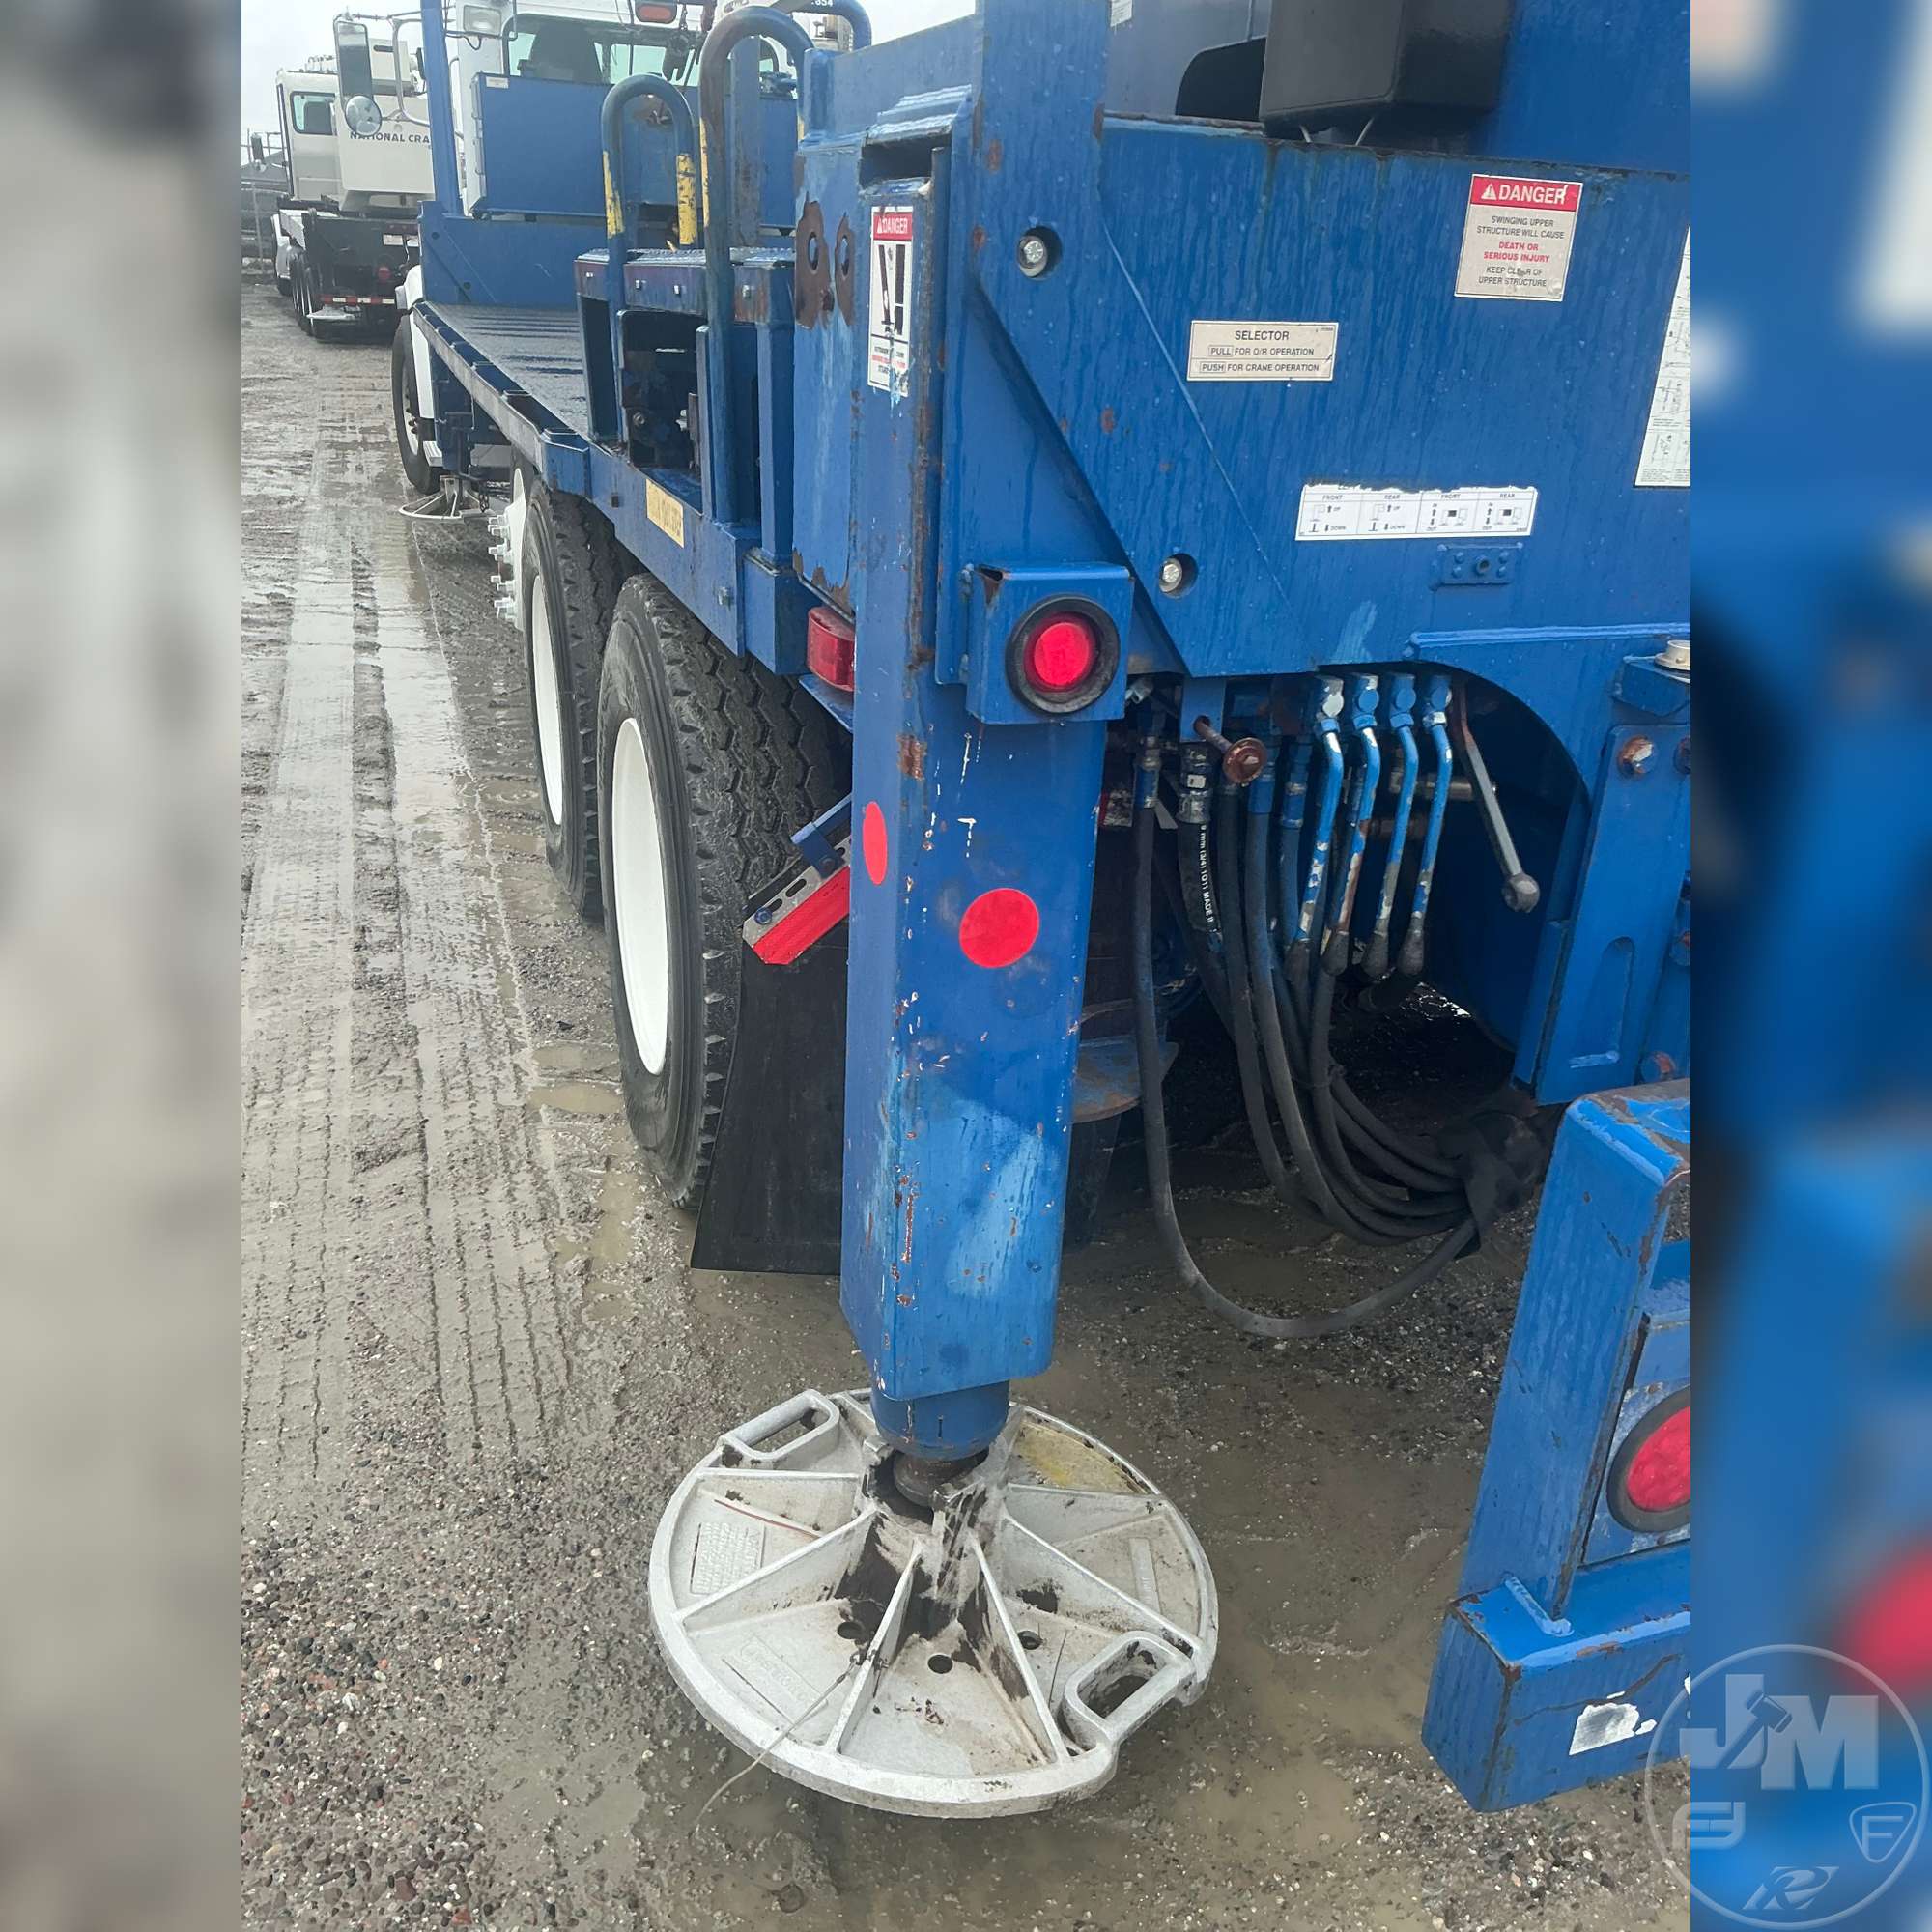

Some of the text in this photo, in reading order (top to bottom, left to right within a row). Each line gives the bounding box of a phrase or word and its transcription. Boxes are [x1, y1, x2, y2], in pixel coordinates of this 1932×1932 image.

[408, 134, 430, 143] CRA
[1498, 185, 1567, 205] DANGER
[1492, 215, 1553, 227] SWINGING UPPER
[1476, 226, 1565, 239] STRUCTURE WILL CAUSE
[1498, 242, 1525, 250] DEATH
[1483, 251, 1550, 263] SERIOUS INJURY
[1486, 266, 1506, 274] KEEP
[1504, 277, 1547, 287] STRUCTURE
[1235, 330, 1290, 341] SELECTOR
[1210, 347, 1232, 355] PULL
[1234, 347, 1251, 355] FOR
[1270, 347, 1315, 356] OPERATION
[1202, 363, 1319, 372] PUSH FOR CRANE OPERATION
[1203, 891, 1213, 916] MADE
